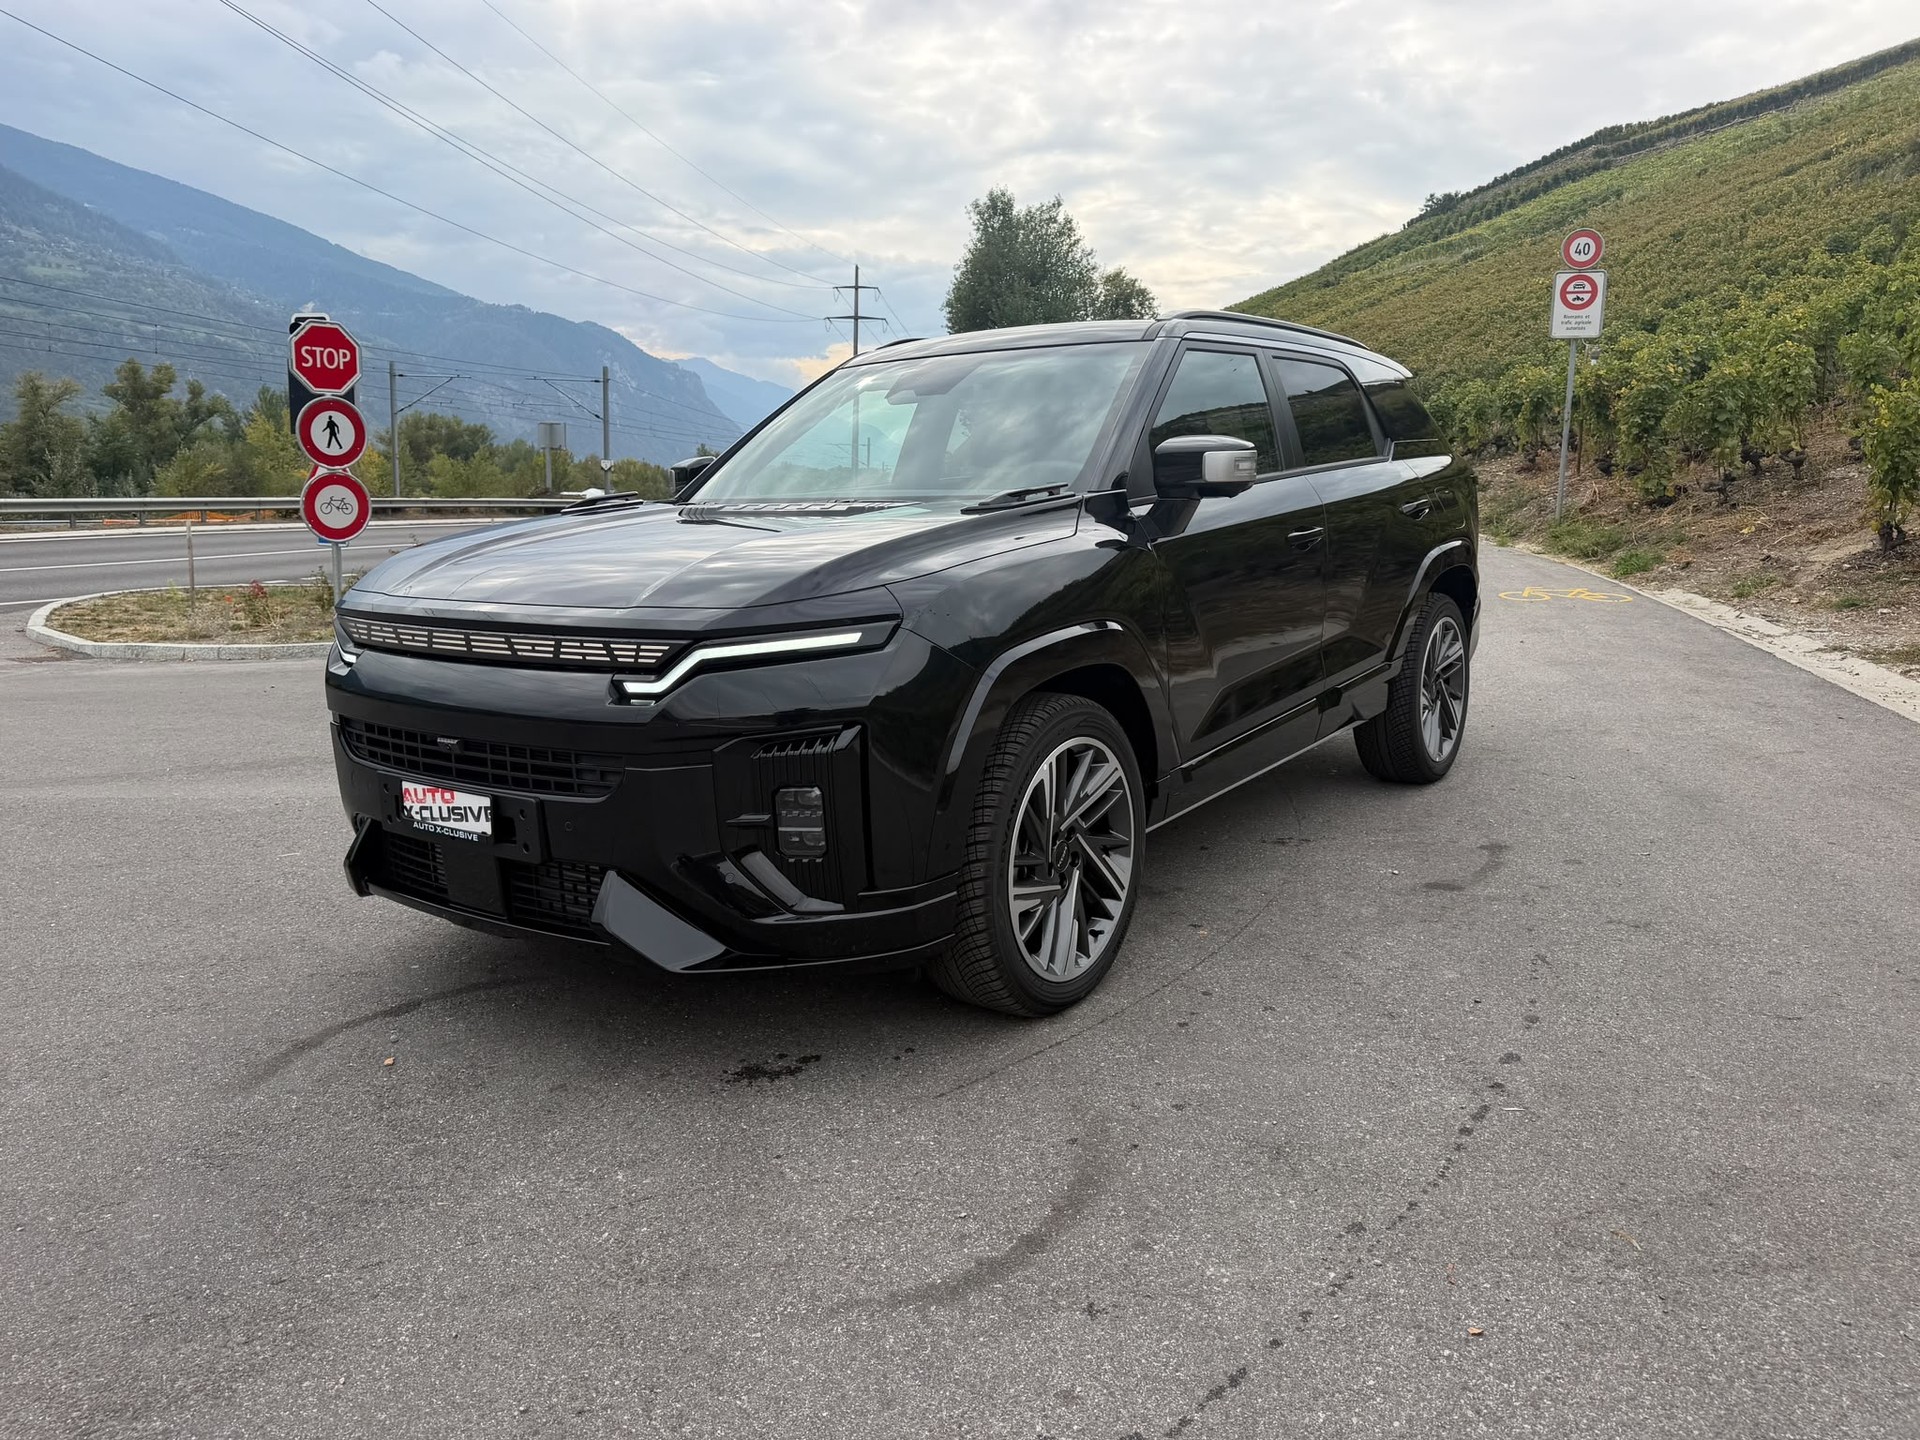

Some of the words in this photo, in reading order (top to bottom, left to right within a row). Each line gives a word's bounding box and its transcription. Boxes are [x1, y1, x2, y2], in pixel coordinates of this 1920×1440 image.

[1574, 242, 1591, 256] 40
[301, 345, 351, 370] STOP
[403, 787, 455, 804] AUTO
[413, 821, 435, 832] AUTO
[435, 826, 478, 842] X-CLUSIVE
